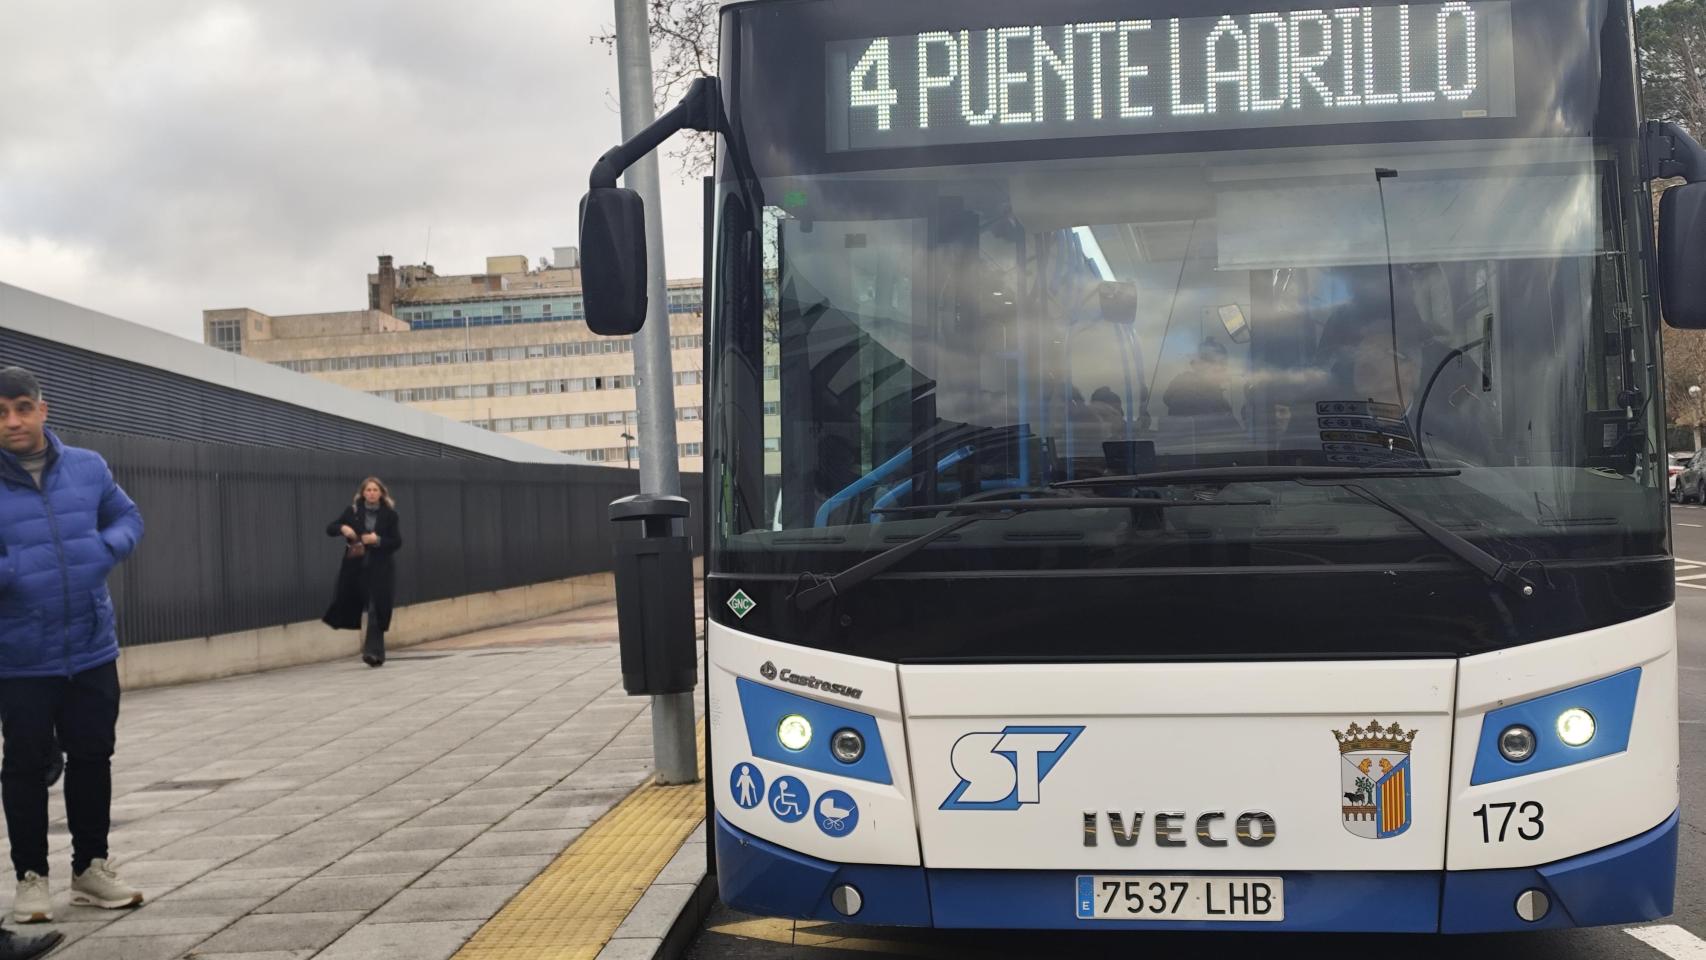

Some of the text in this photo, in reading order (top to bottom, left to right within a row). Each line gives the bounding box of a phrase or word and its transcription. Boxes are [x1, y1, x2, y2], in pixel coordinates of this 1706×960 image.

[851, 1, 1477, 129] 4 PUENTE LADRILLO
[731, 599, 750, 610] GNC
[779, 668, 863, 700] Castrosua
[949, 731, 1073, 805] ST
[1082, 810, 1277, 848] IVECO
[1473, 801, 1544, 843] 173
[1082, 881, 1272, 915] E 7537 LHB
